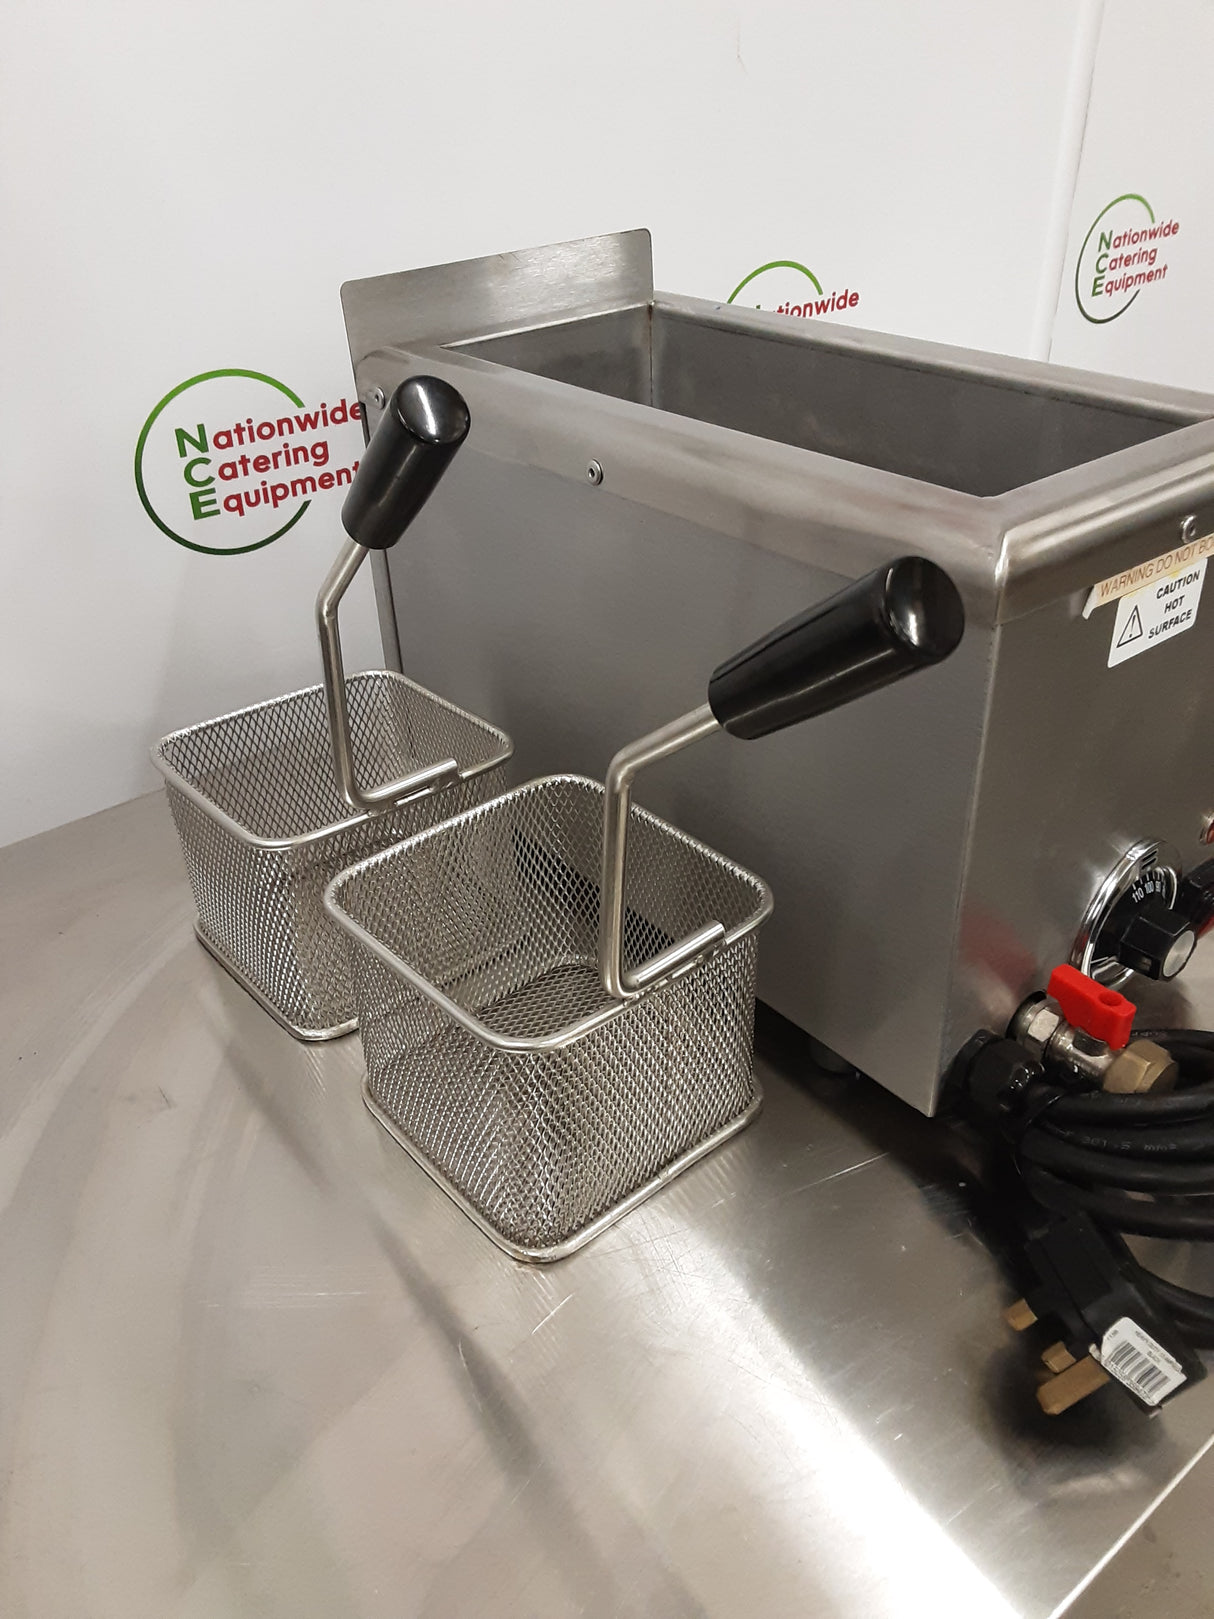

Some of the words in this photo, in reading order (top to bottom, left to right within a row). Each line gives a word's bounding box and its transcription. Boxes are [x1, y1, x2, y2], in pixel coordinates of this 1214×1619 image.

[1098, 219, 1179, 253] Nationwide
[1095, 247, 1157, 274] Catering
[1091, 264, 1168, 298] Equipment
[174, 398, 362, 458] Nationwide
[184, 441, 329, 488] Catering
[1100, 563, 1153, 598] WARNING
[1156, 554, 1172, 574] DO
[1174, 541, 1198, 564] NOT
[1156, 570, 1200, 600] CAUTION
[1164, 595, 1185, 614] HOT
[1148, 609, 1193, 639] SURFACE
[1132, 887, 1144, 903] 110
